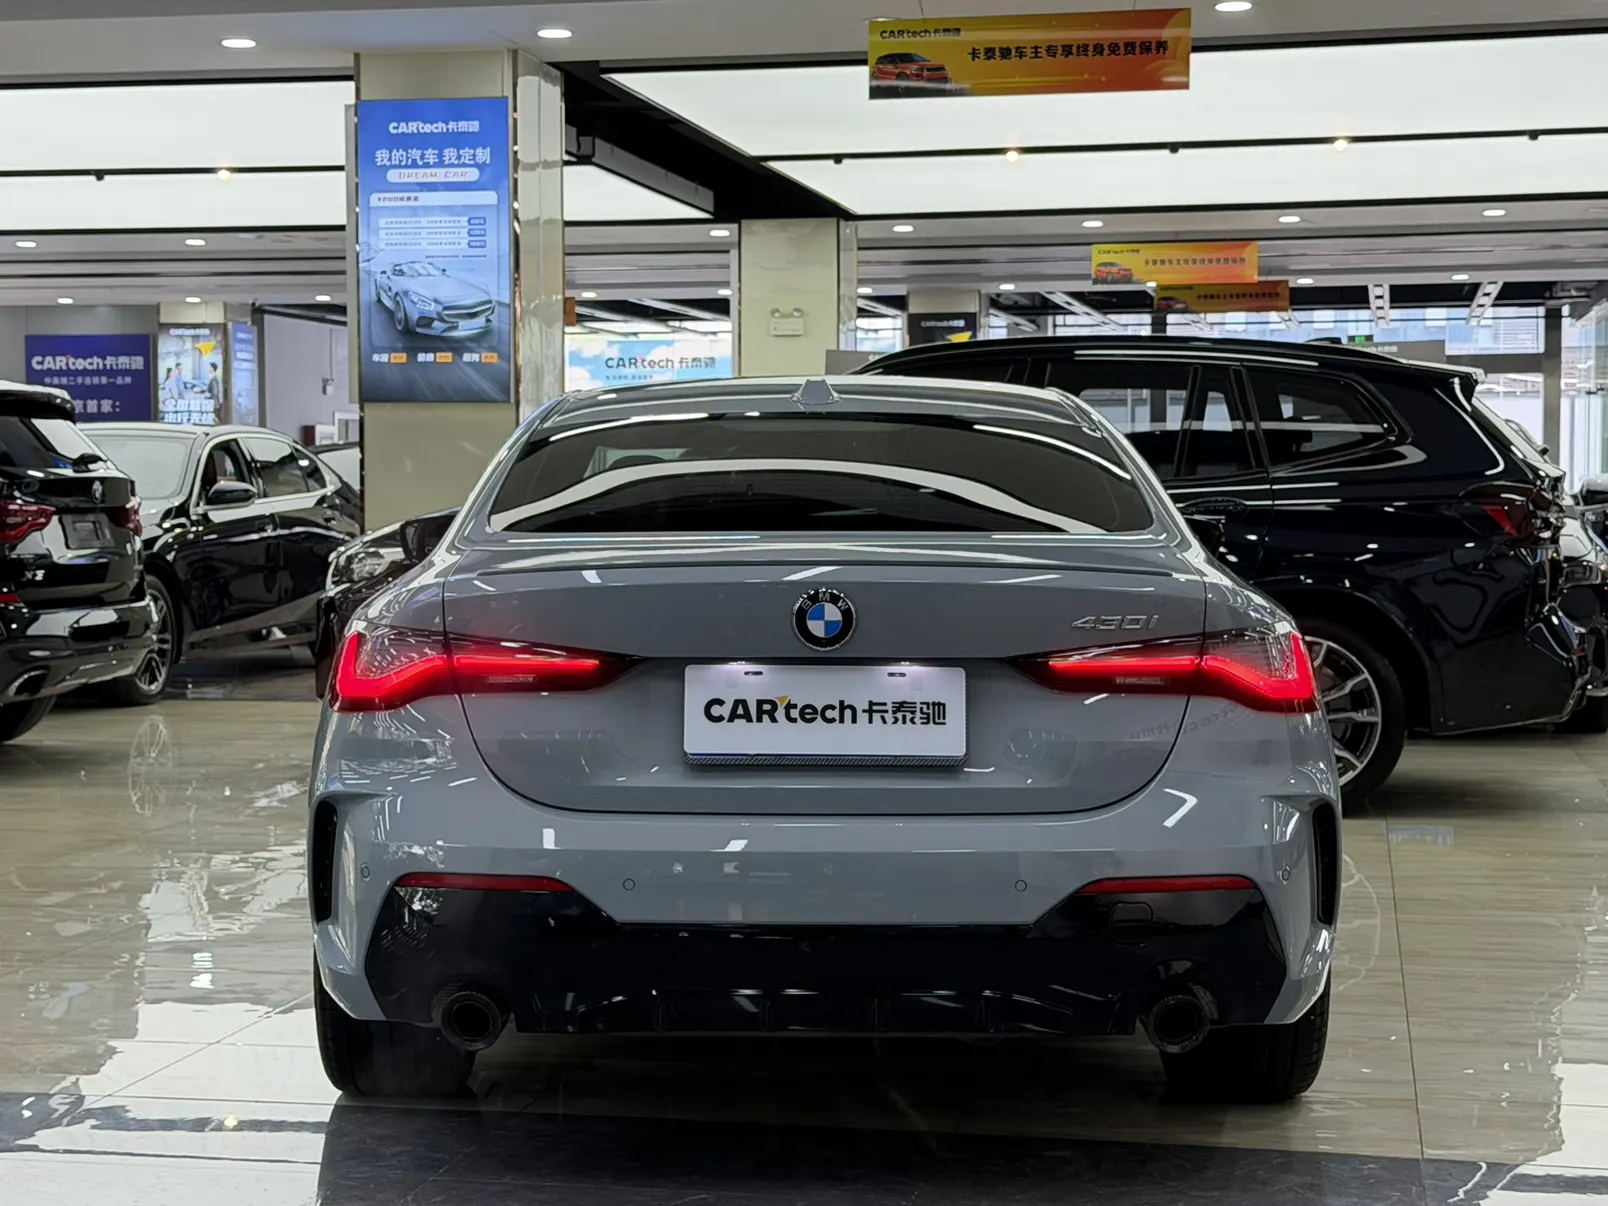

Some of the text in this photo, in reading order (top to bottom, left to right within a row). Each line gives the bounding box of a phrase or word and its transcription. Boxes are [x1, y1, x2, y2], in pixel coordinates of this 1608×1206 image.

[967, 39, 1169, 61] 卡泰驰车主专享终身免费保养
[375, 146, 490, 166] 我的汽车 我定制
[444, 170, 468, 178] CAR
[801, 591, 849, 611] BMW
[1071, 614, 1160, 630] 430i
[862, 699, 947, 726] 卡泰驰
